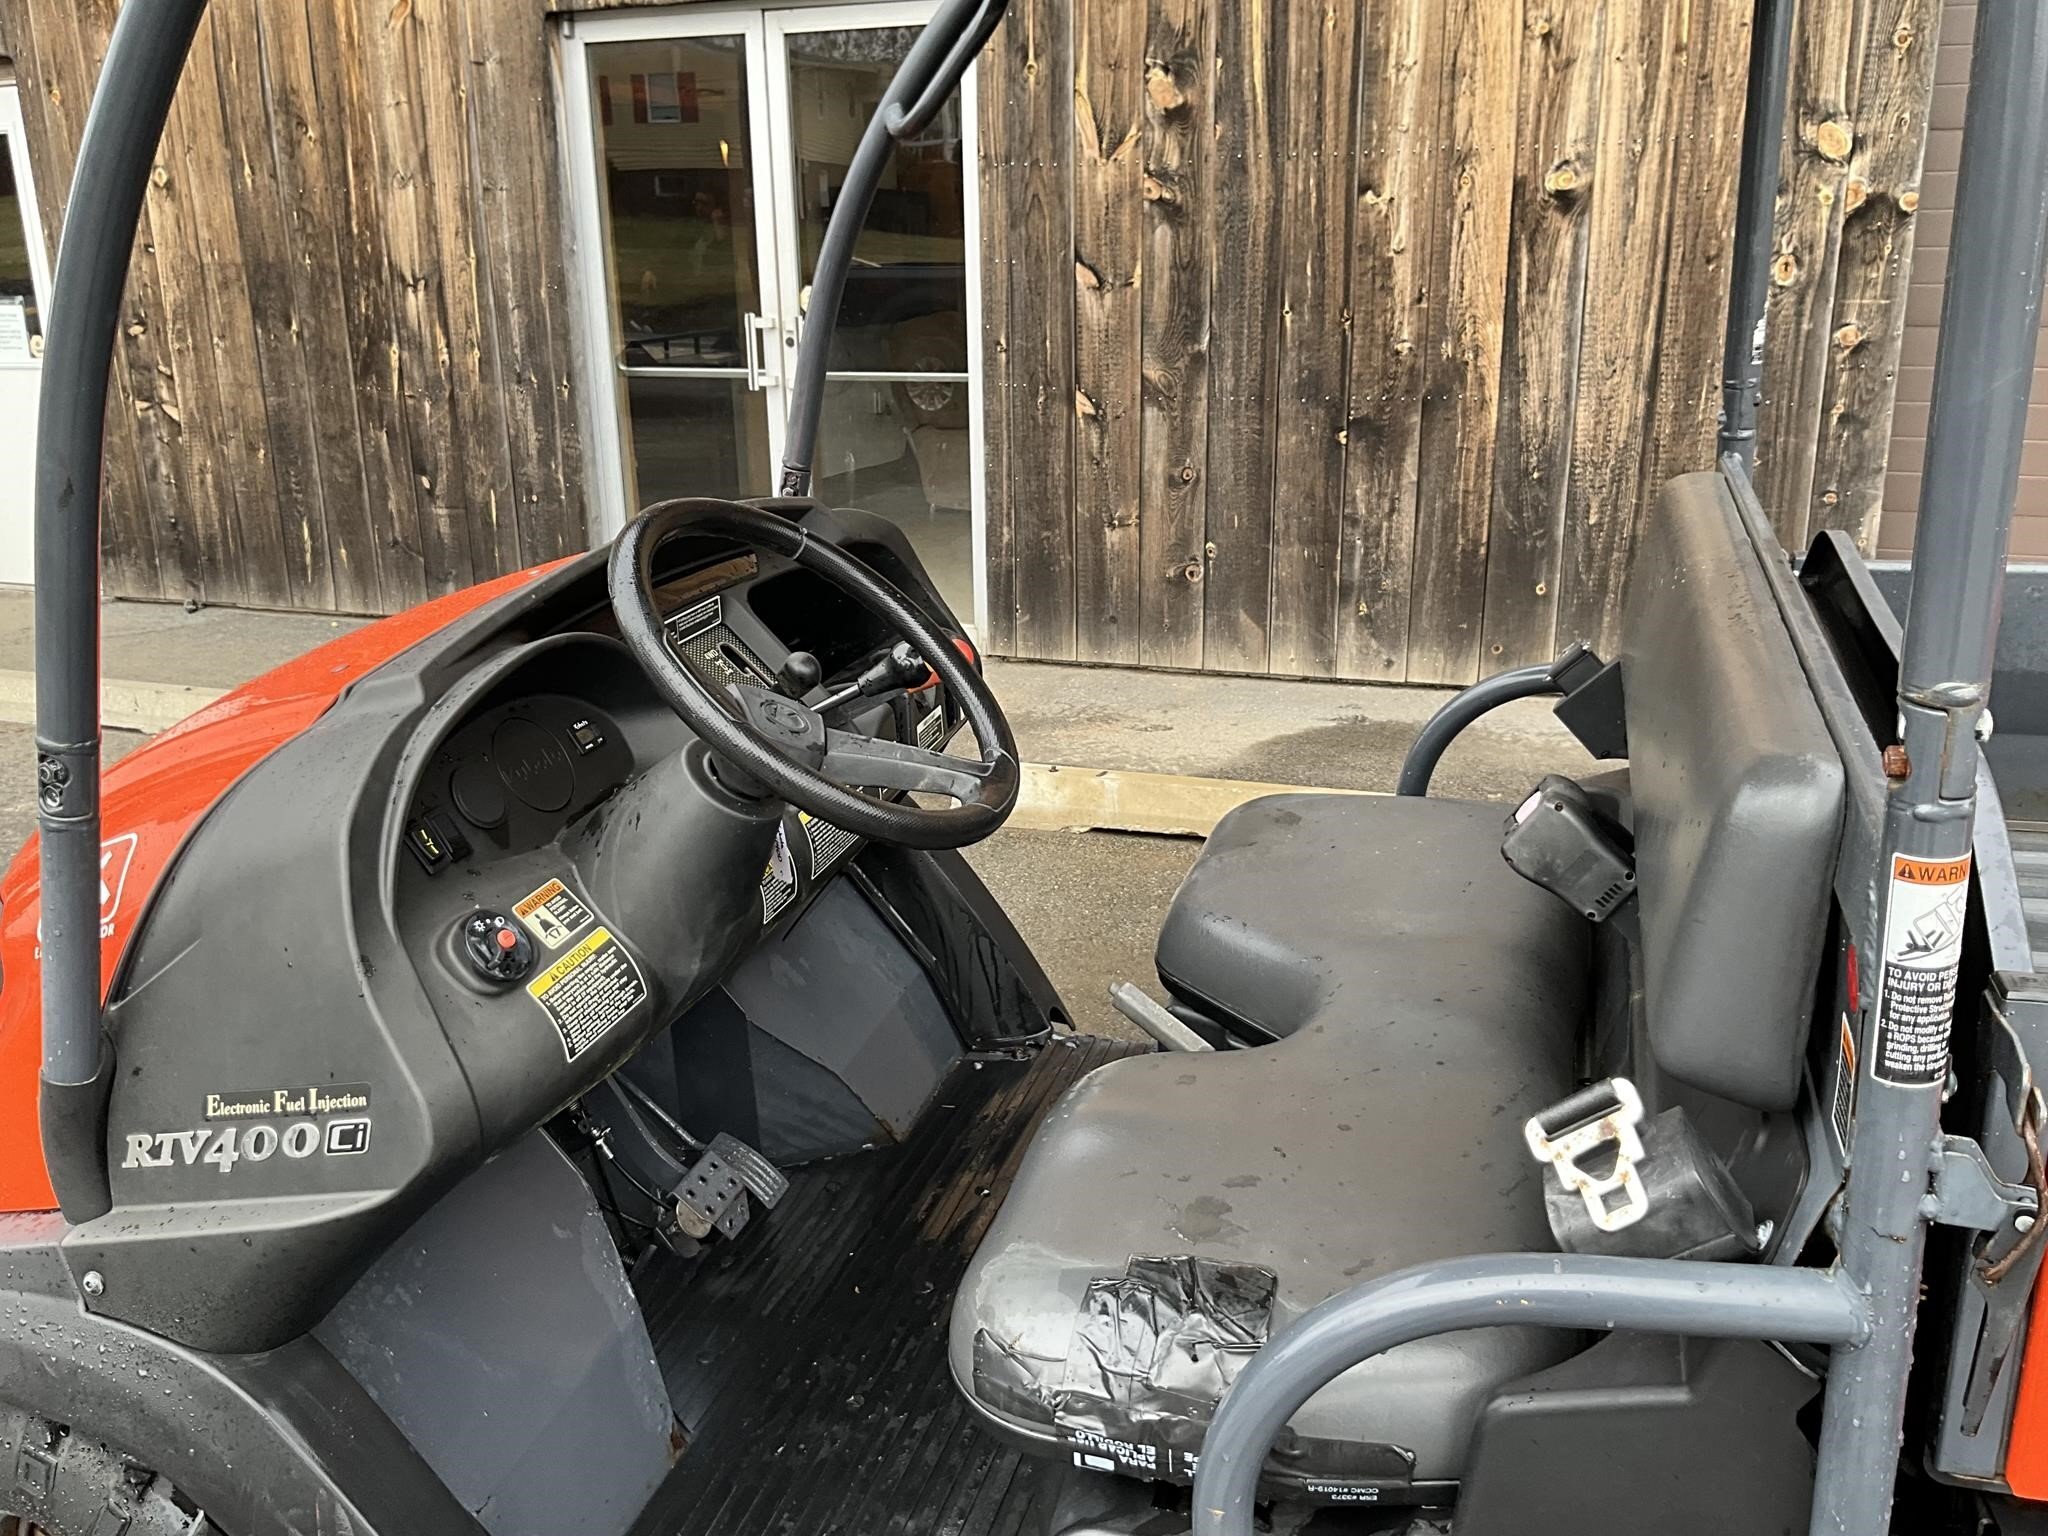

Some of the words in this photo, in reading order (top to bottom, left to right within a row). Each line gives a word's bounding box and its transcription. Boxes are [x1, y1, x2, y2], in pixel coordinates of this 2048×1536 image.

[526, 882, 561, 909] WARNING
[556, 944, 592, 975] CAUTION
[1888, 967, 1902, 978] TO
[1904, 971, 1936, 981] AVOID
[1888, 977, 1925, 991] INJURY
[1927, 983, 1941, 991] OR
[1885, 989, 1890, 998] 1.
[1891, 991, 1902, 1001] Do
[1903, 995, 1916, 1004] not
[1891, 1001, 1928, 1013] Protective
[1890, 1010, 1900, 1019] for
[1901, 1015, 1915, 1024] any
[1881, 1019, 1887, 1028] 2.
[1889, 1021, 1898, 1030] Do
[1900, 1025, 1913, 1033] not
[1894, 1032, 1916, 1043] ROPS
[1886, 1051, 1912, 1063] cutting
[1913, 1055, 1926, 1063] any
[1885, 1060, 1912, 1071] weaken
[1914, 1063, 1925, 1071] the
[206, 1093, 270, 1117] Electronic
[273, 1089, 306, 1113] Fuel
[308, 1088, 368, 1115] Injection
[121, 1122, 321, 1174] RTV400
[1075, 1430, 1134, 1450] RODILLO
[1098, 1442, 1156, 1462] APLICAR
[1137, 1444, 1155, 1454] EL
[1118, 1455, 1156, 1470] PARA
